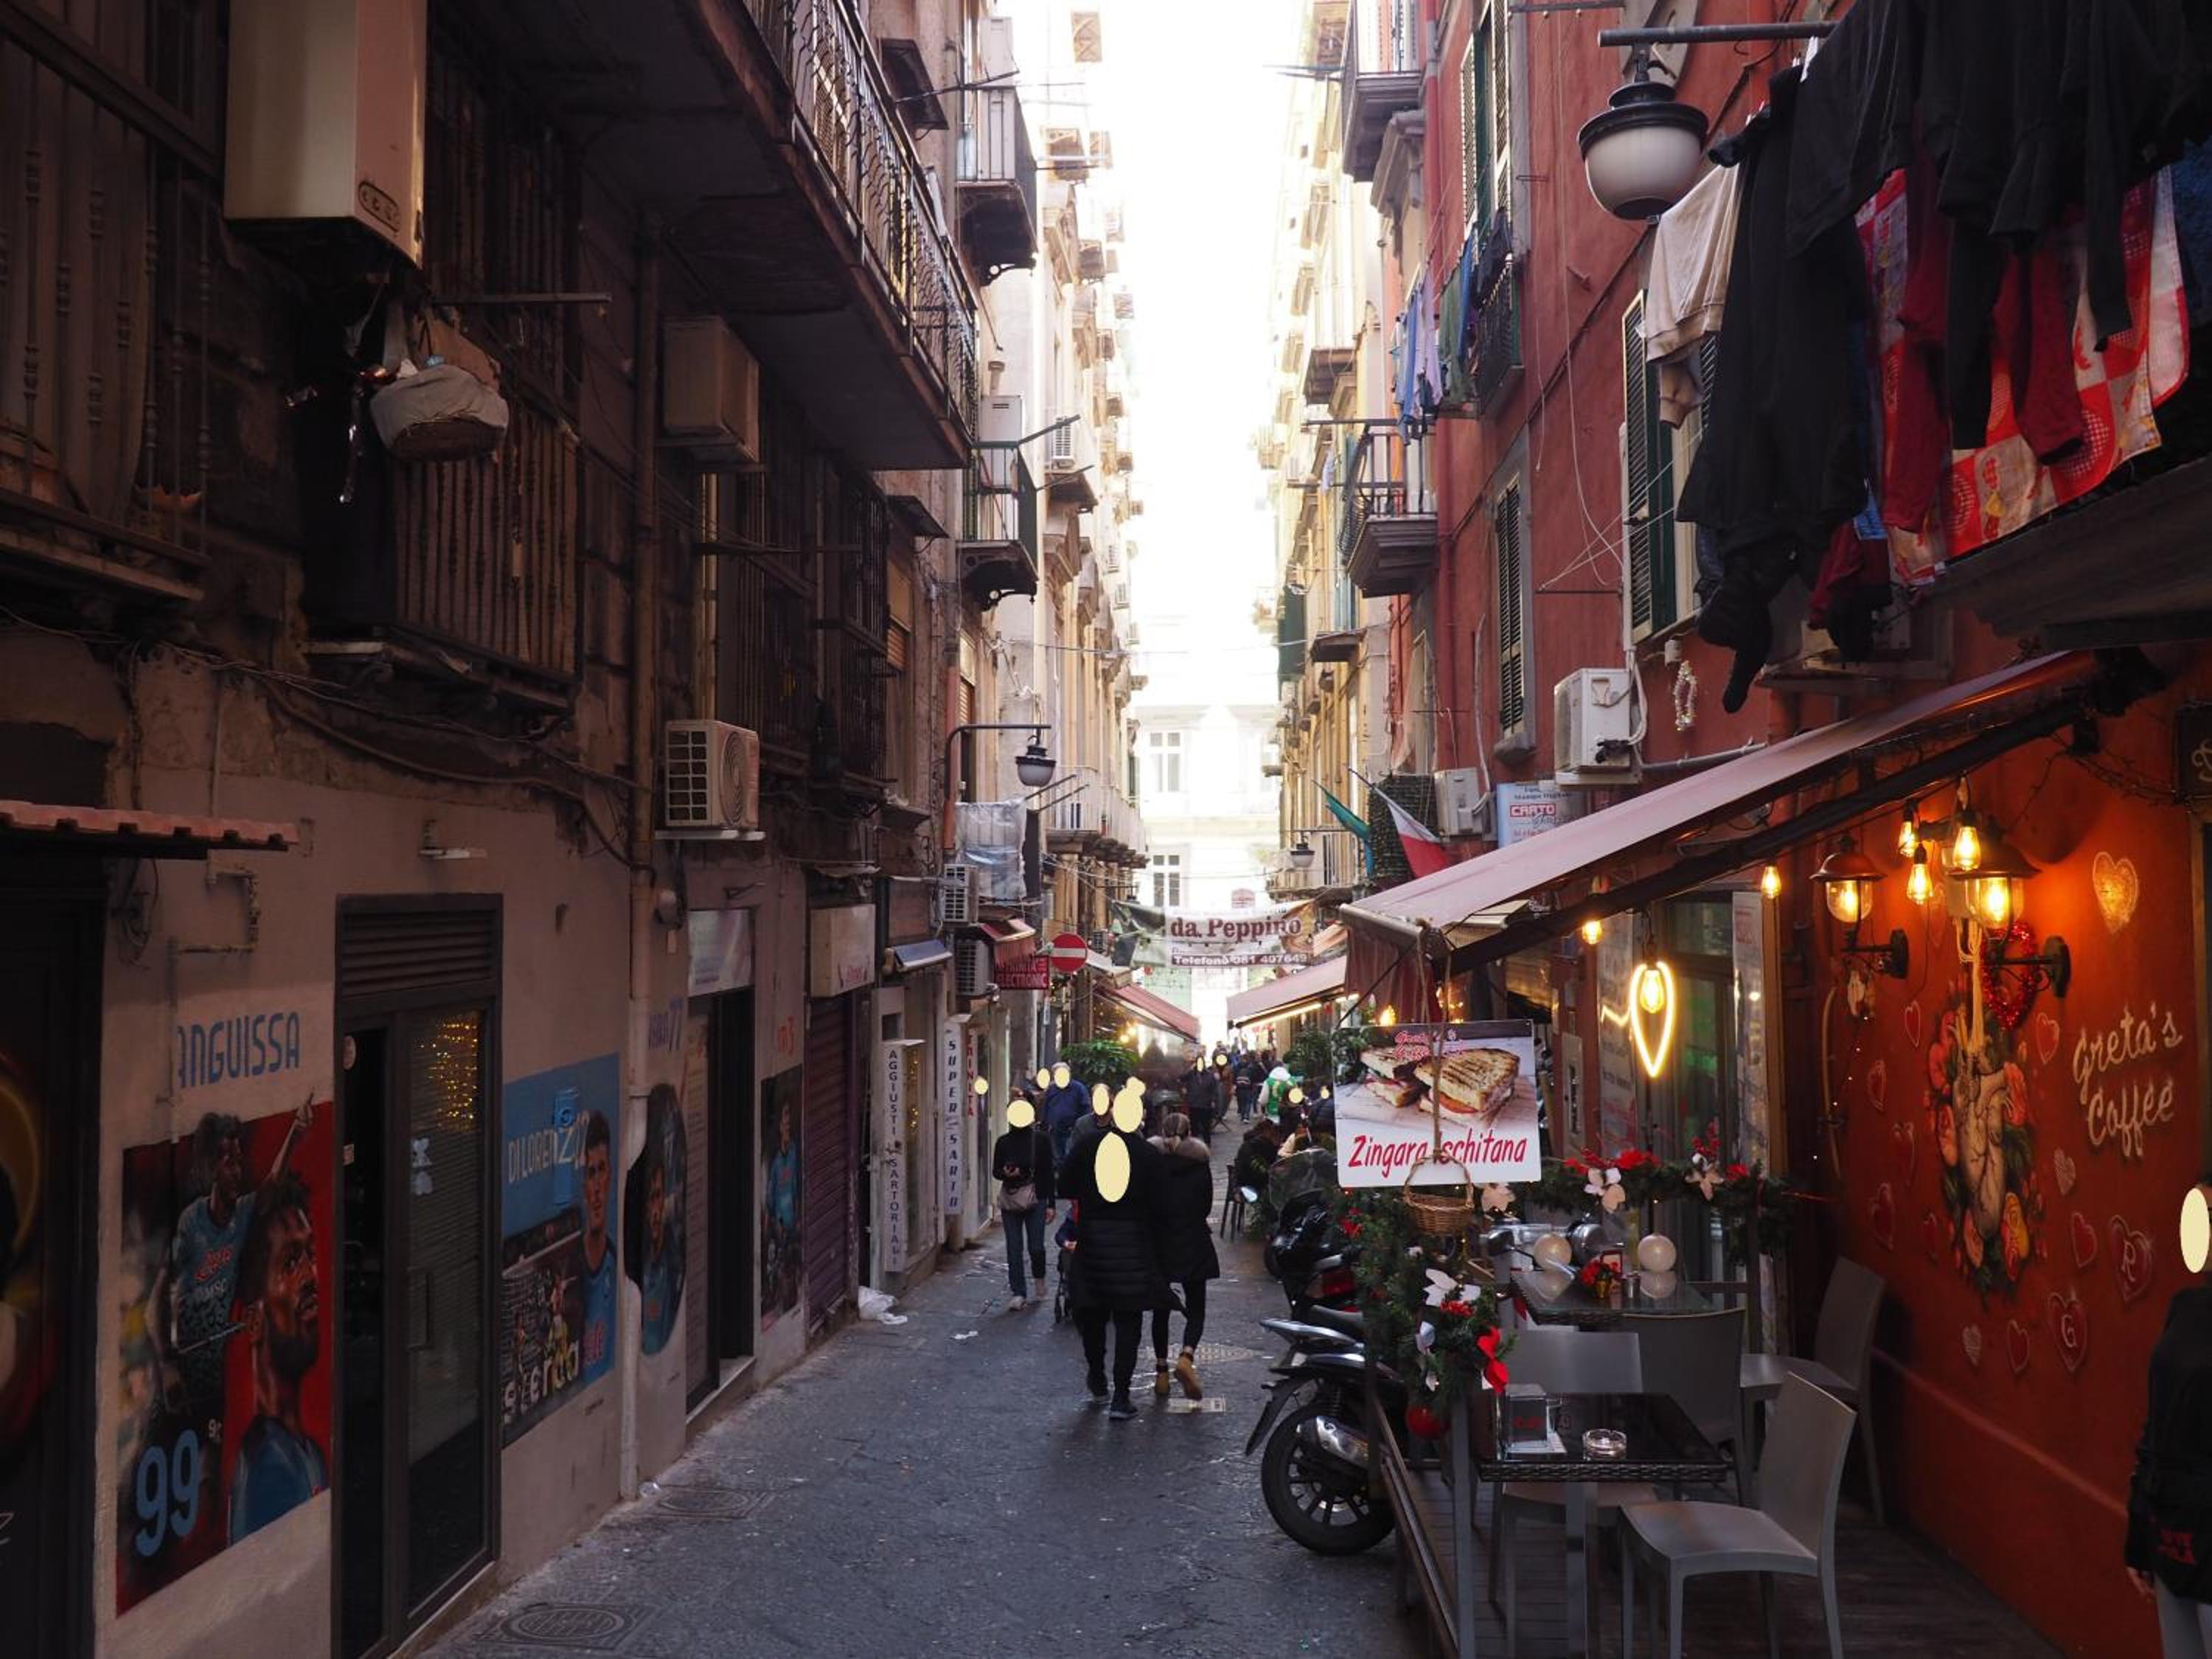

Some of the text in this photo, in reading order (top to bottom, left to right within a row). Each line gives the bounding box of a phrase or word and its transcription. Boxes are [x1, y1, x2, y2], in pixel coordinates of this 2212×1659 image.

[1206, 914, 1303, 943] Peppino
[888, 1050, 897, 1135] AGGIUSTI
[948, 1040, 957, 1114] SUPER
[2072, 1001, 2183, 1105] Greta's
[1348, 1135, 1428, 1178] Zingara
[2087, 1077, 2174, 1157] Coffee
[133, 1428, 201, 1559] 99
